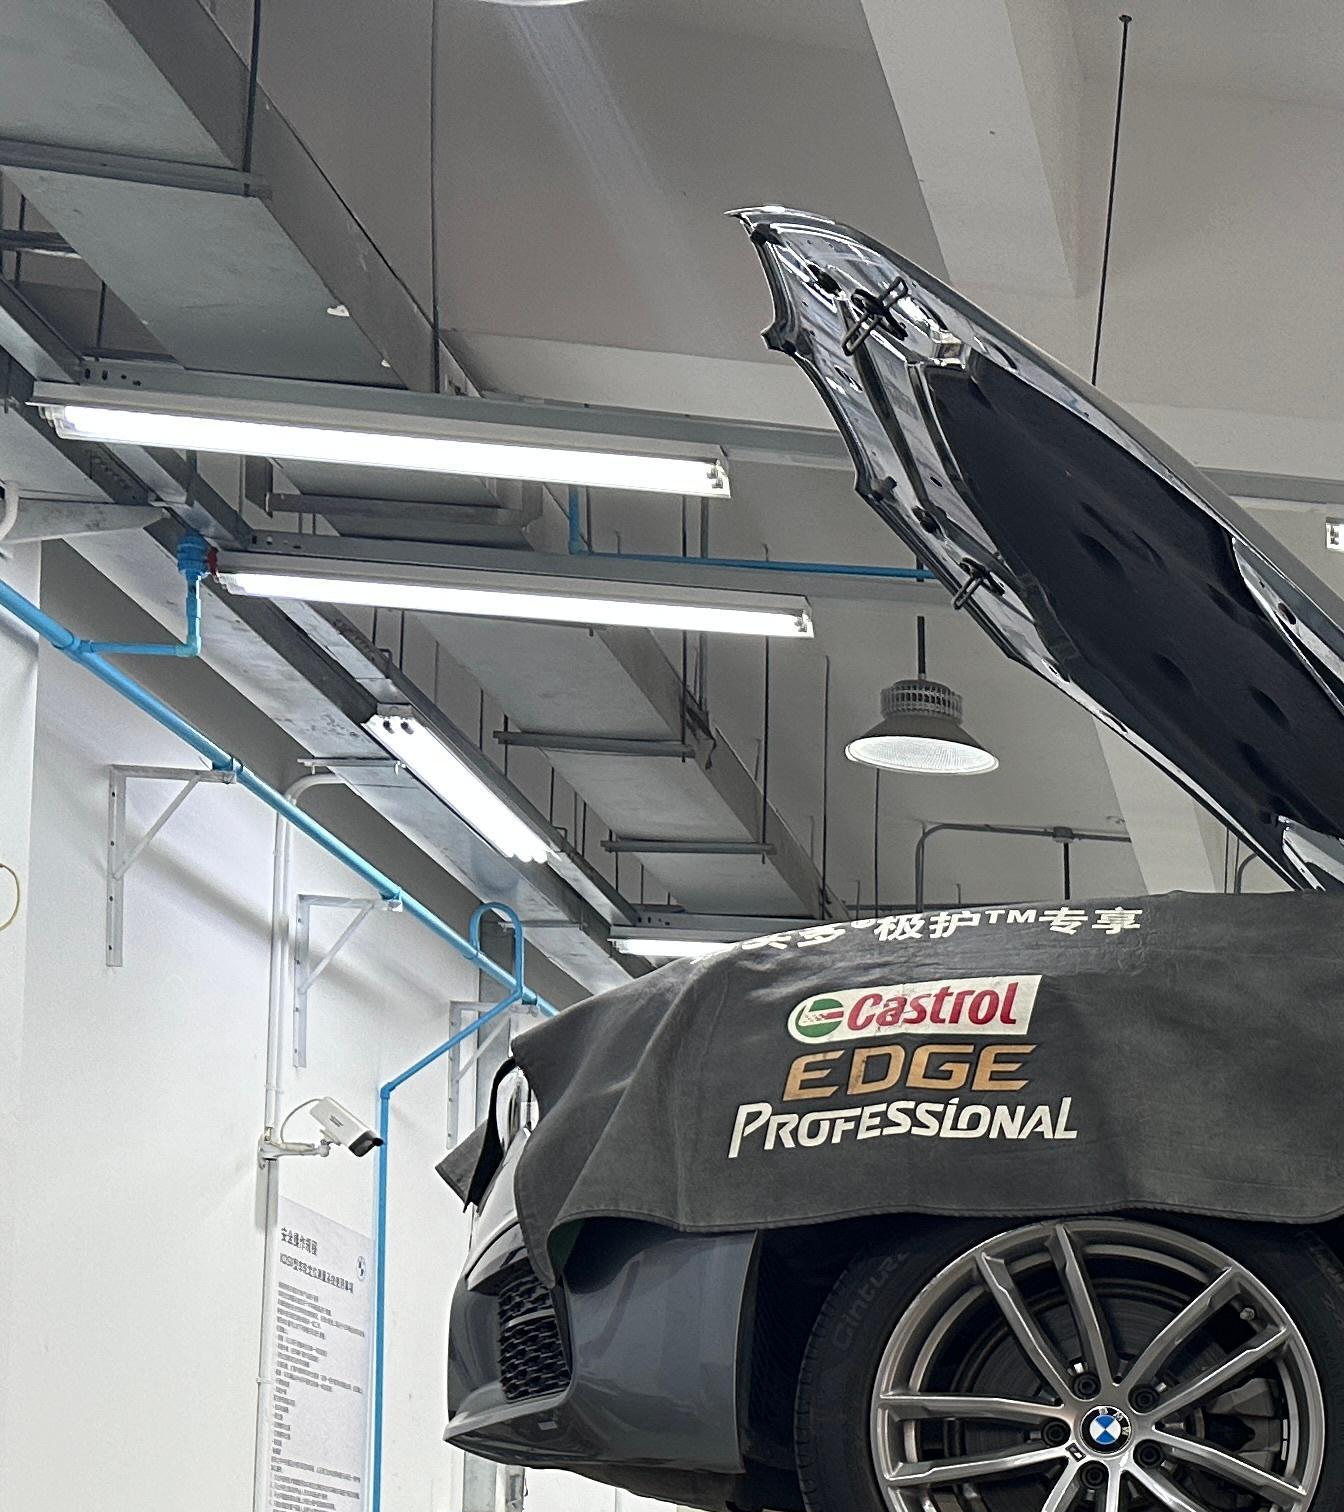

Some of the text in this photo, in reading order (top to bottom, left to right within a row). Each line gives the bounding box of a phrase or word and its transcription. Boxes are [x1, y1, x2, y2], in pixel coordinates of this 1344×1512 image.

[847, 981, 1019, 1031] Castrol
[782, 1043, 1038, 1102] EDGE
[728, 1096, 1079, 1159] PROFESSIONAL
